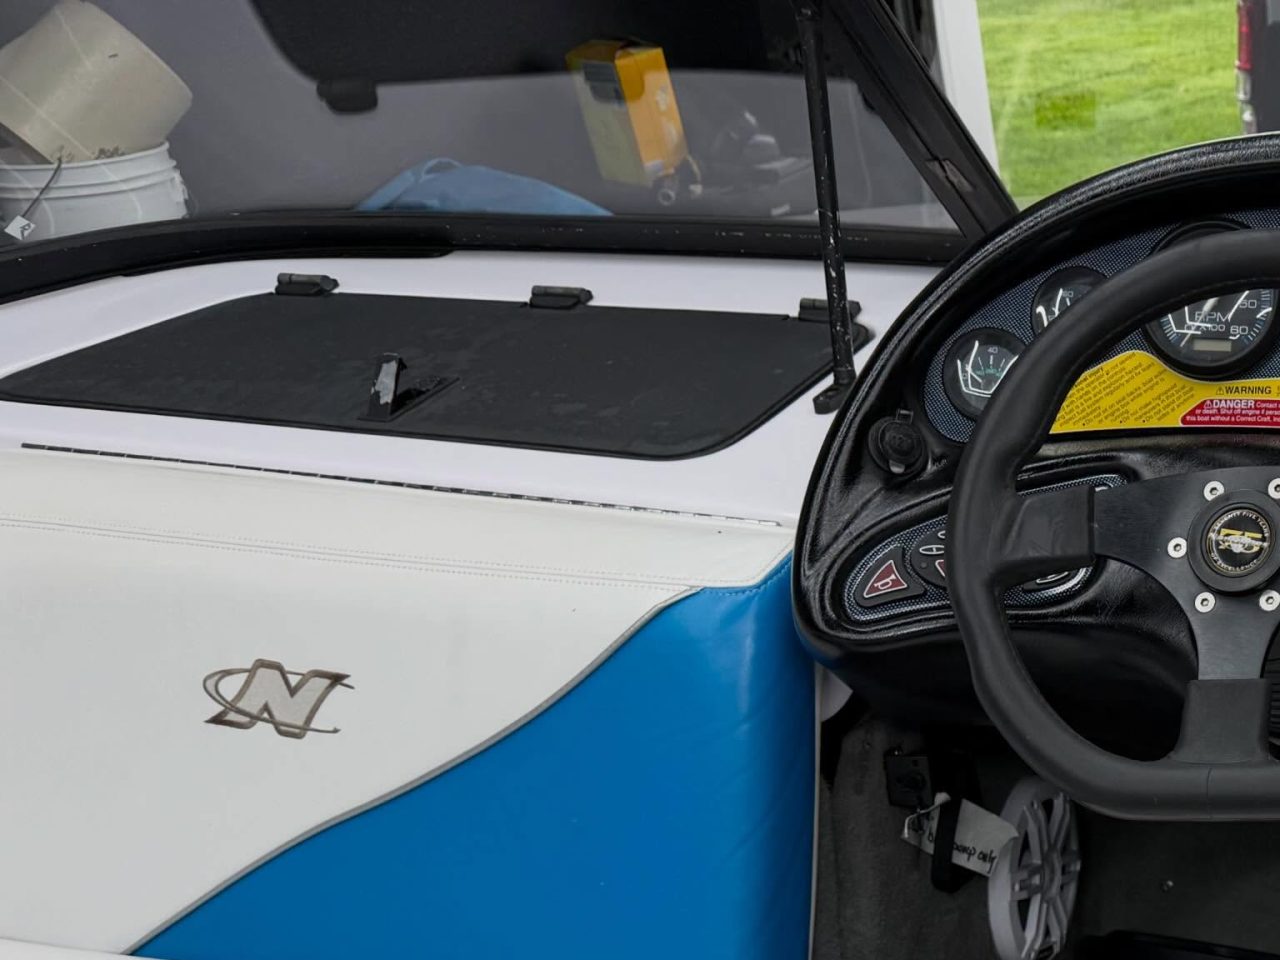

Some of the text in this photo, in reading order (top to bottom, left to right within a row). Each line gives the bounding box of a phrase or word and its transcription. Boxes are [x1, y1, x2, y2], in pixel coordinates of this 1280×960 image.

[1195, 311, 1231, 322] RPM
[1230, 325, 1249, 335] 60
[1225, 386, 1272, 395] WARNING
[1213, 400, 1255, 408] DANGER
